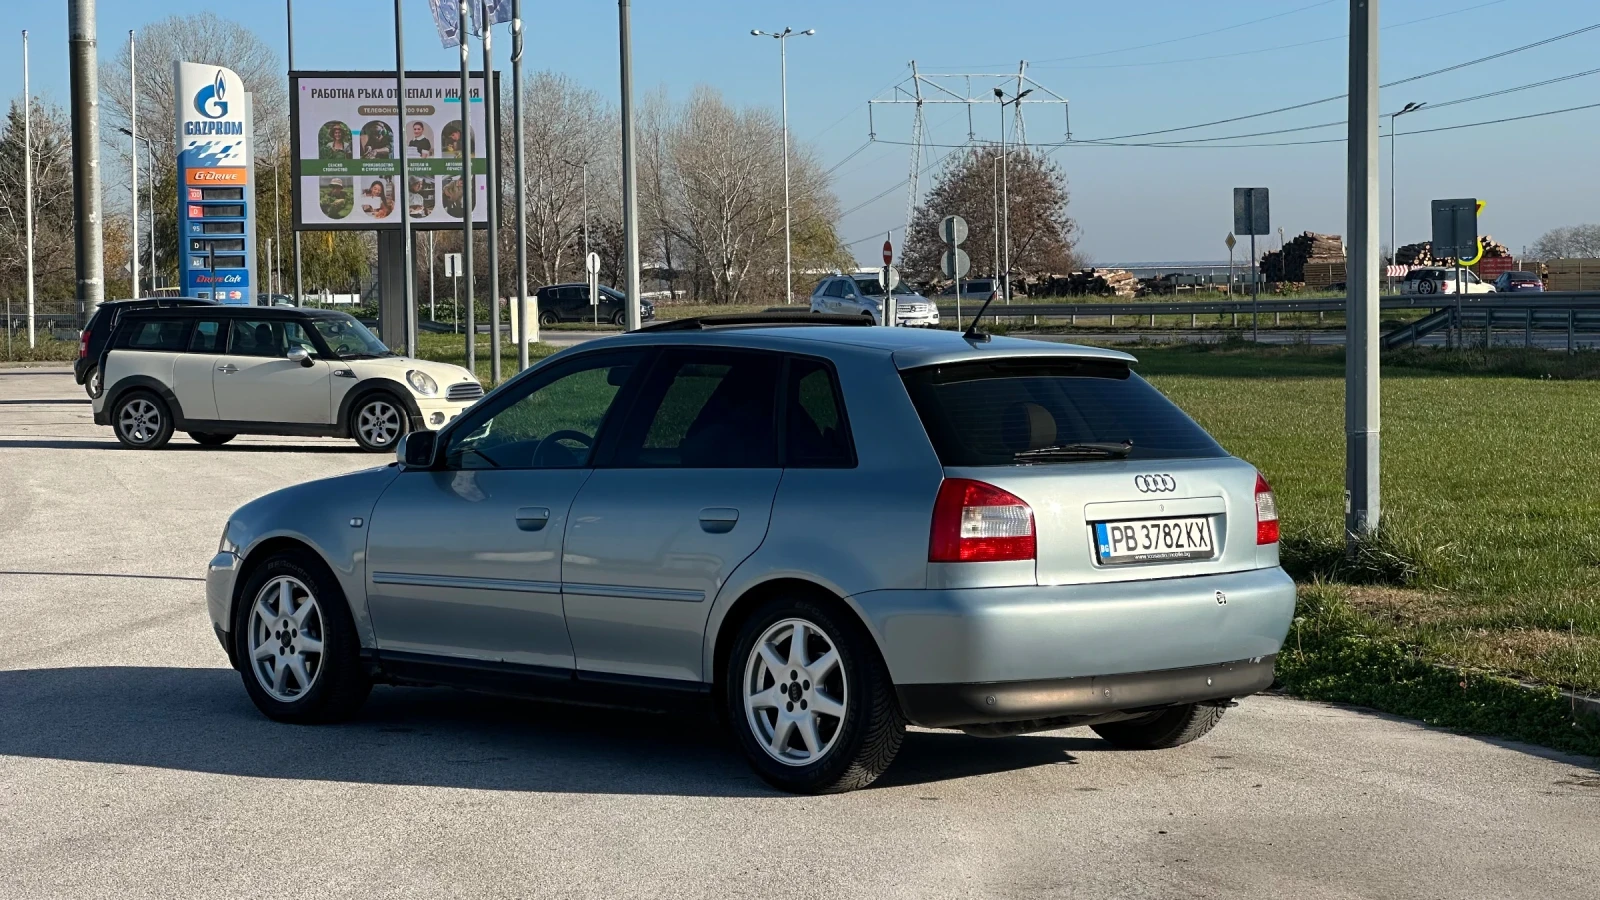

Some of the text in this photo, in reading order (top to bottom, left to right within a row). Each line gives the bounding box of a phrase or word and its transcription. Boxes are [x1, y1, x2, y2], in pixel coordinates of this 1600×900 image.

[311, 88, 355, 98] РАБОТНА
[358, 88, 384, 98] РЪКА
[436, 88, 442, 98] И
[445, 88, 479, 99] ИНЯ
[184, 121, 242, 136] GAZPROM
[1110, 526, 1138, 552] PB
[1100, 544, 1110, 553] BG
